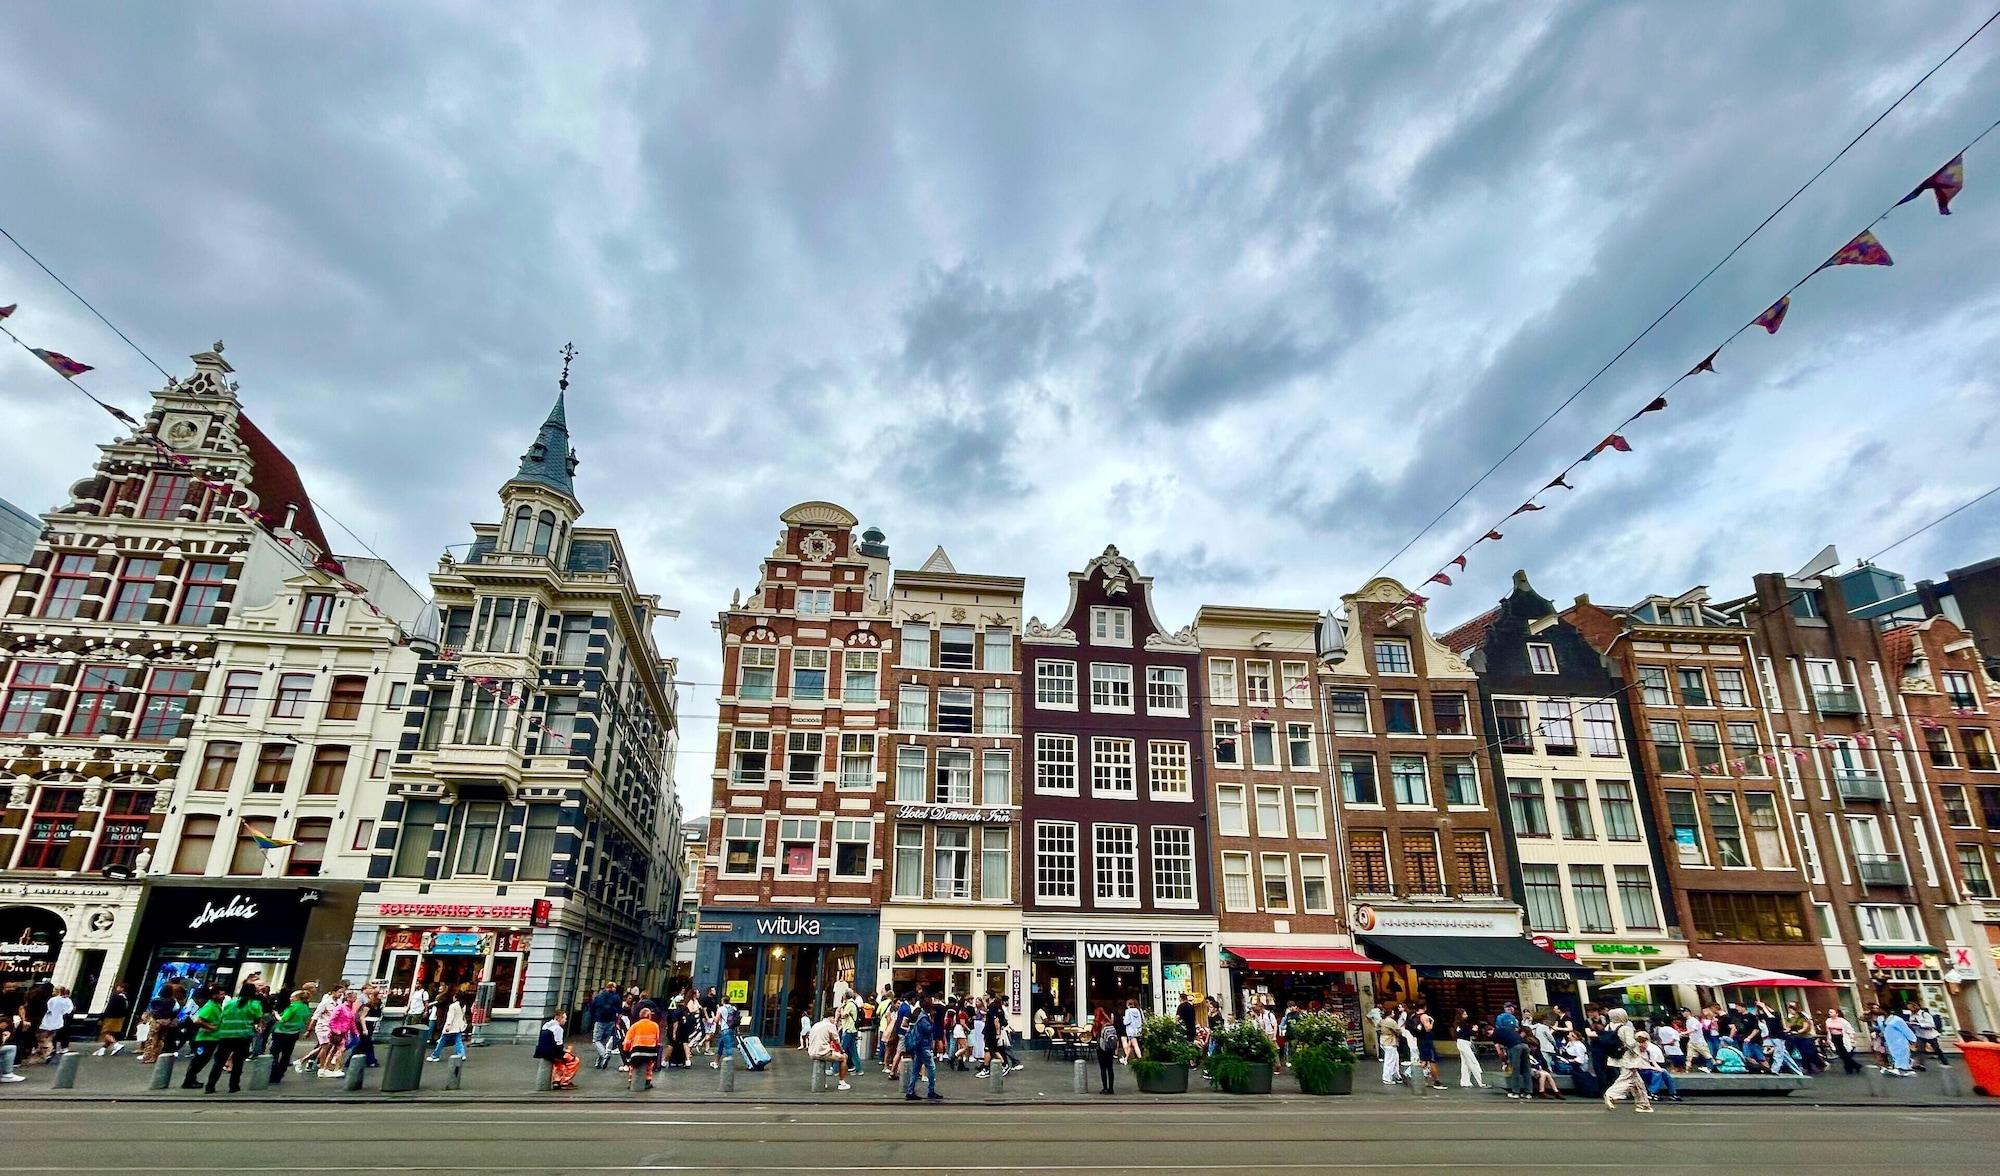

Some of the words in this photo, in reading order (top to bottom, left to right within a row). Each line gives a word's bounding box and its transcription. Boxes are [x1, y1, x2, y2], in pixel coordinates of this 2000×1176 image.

[896, 805, 930, 819] Hotel
[930, 806, 981, 822] Damrak
[982, 810, 1010, 822] Inn
[33, 823, 73, 831] TASTING
[106, 825, 143, 833] TASTING
[37, 831, 67, 839] ROOM
[189, 895, 258, 928] drake's
[379, 903, 470, 917] SOUVENIRS
[473, 906, 485, 917] &
[757, 915, 820, 935] wituka
[896, 942, 939, 959] VLAAMSE
[940, 943, 970, 960] FRITES
[1086, 943, 1130, 959] WOK
[1127, 944, 1138, 954] TO
[1138, 944, 1150, 955] GO
[1443, 970, 1463, 978] HENRI
[1464, 971, 1487, 979] WILLIG
[1547, 972, 1571, 980] KAZEN
